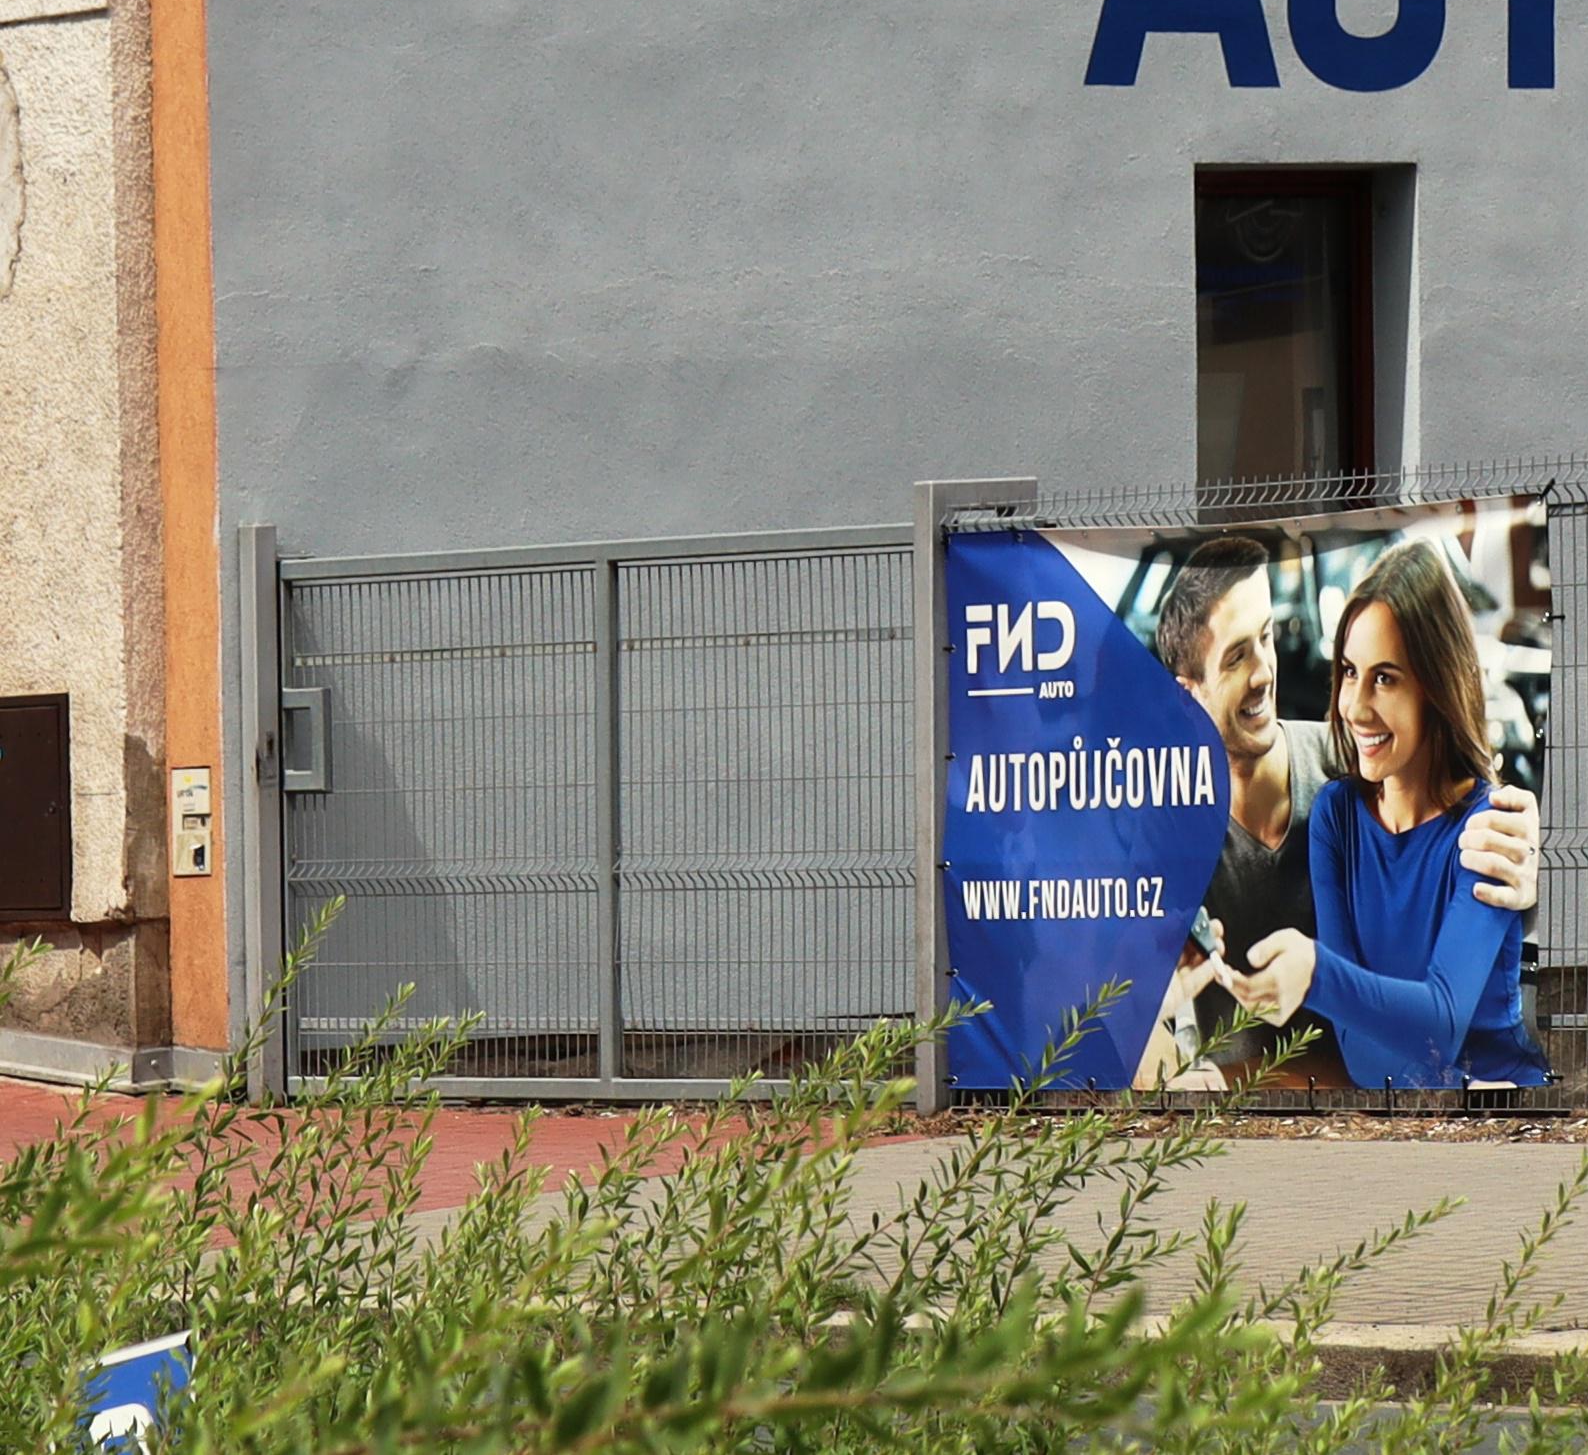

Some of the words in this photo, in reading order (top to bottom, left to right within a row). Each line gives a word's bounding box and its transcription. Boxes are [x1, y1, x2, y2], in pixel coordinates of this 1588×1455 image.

[1039, 680, 1074, 699] AUTO
[965, 735, 1215, 813] AUTOPŮJČOVNA
[962, 876, 1164, 920] WWW.FNDAUTO.CZ
